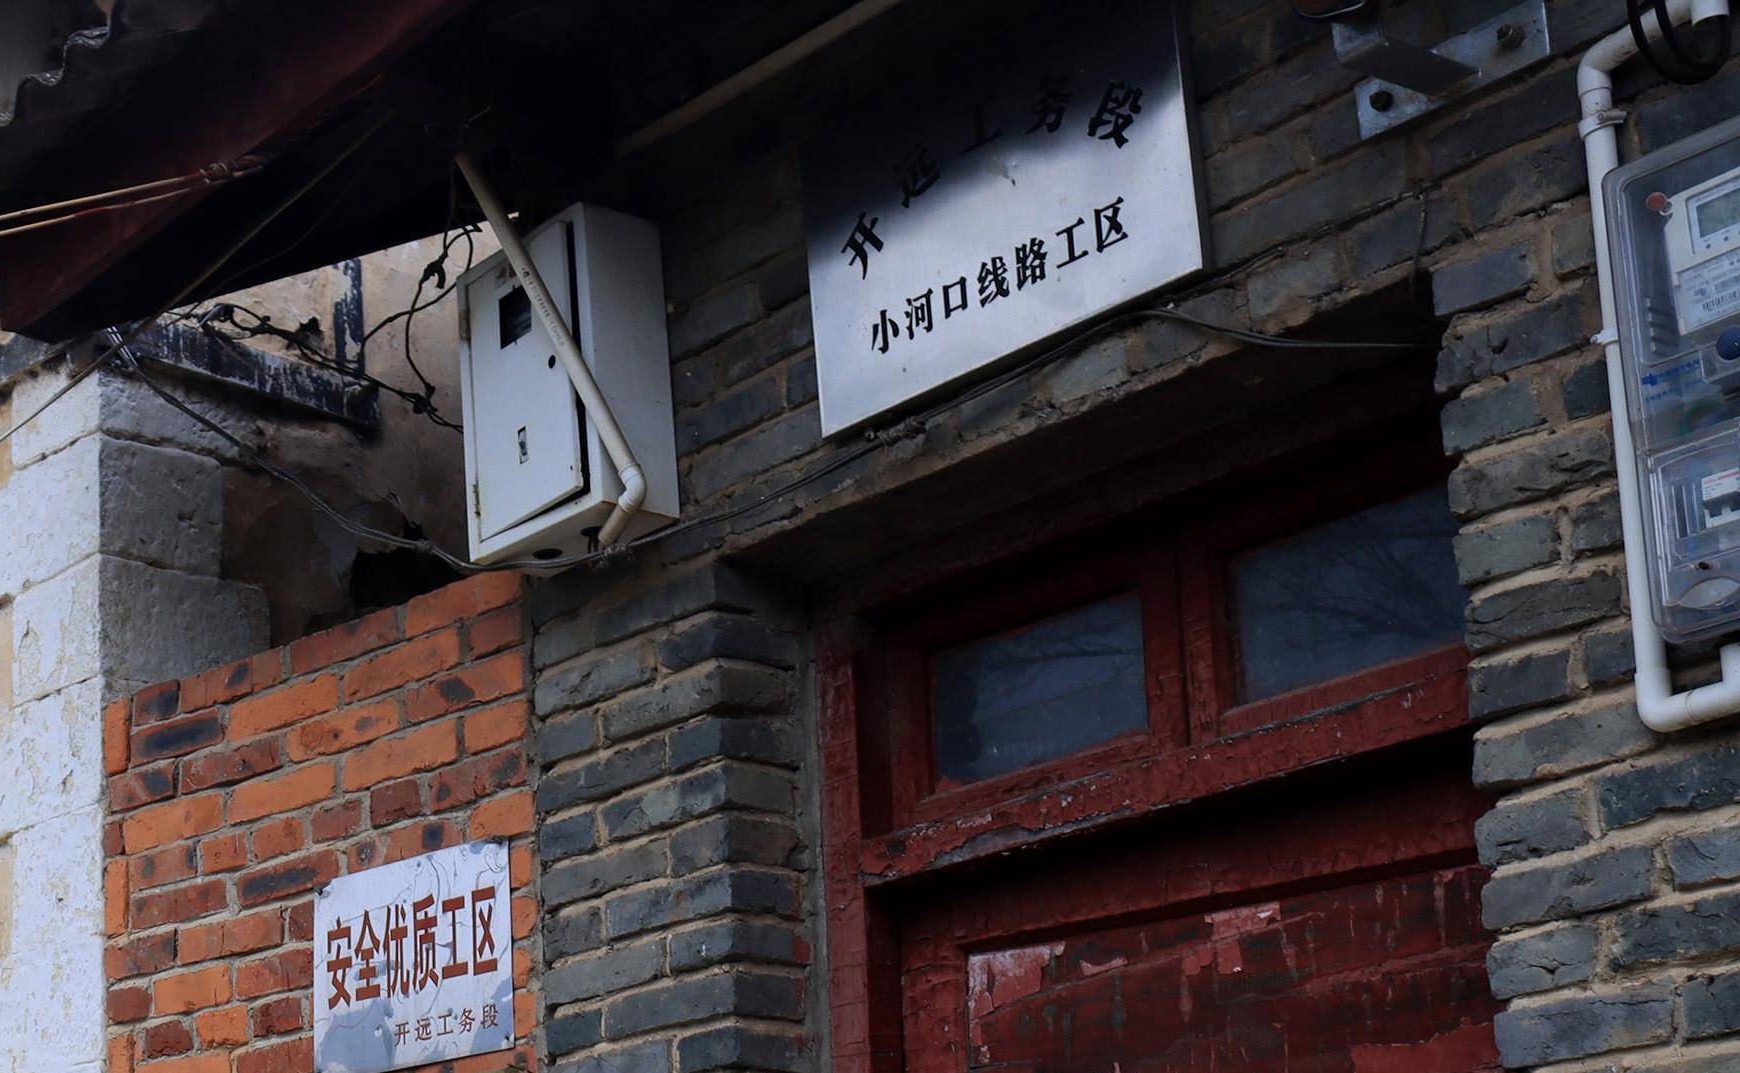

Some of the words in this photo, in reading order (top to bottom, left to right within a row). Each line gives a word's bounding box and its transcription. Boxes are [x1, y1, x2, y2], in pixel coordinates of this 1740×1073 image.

[841, 73, 1143, 280] 开远工务段
[871, 197, 1129, 355] 小河口线路工区
[327, 885, 498, 1010] 安全优质工区
[393, 1003, 499, 1047] 开远工务段
